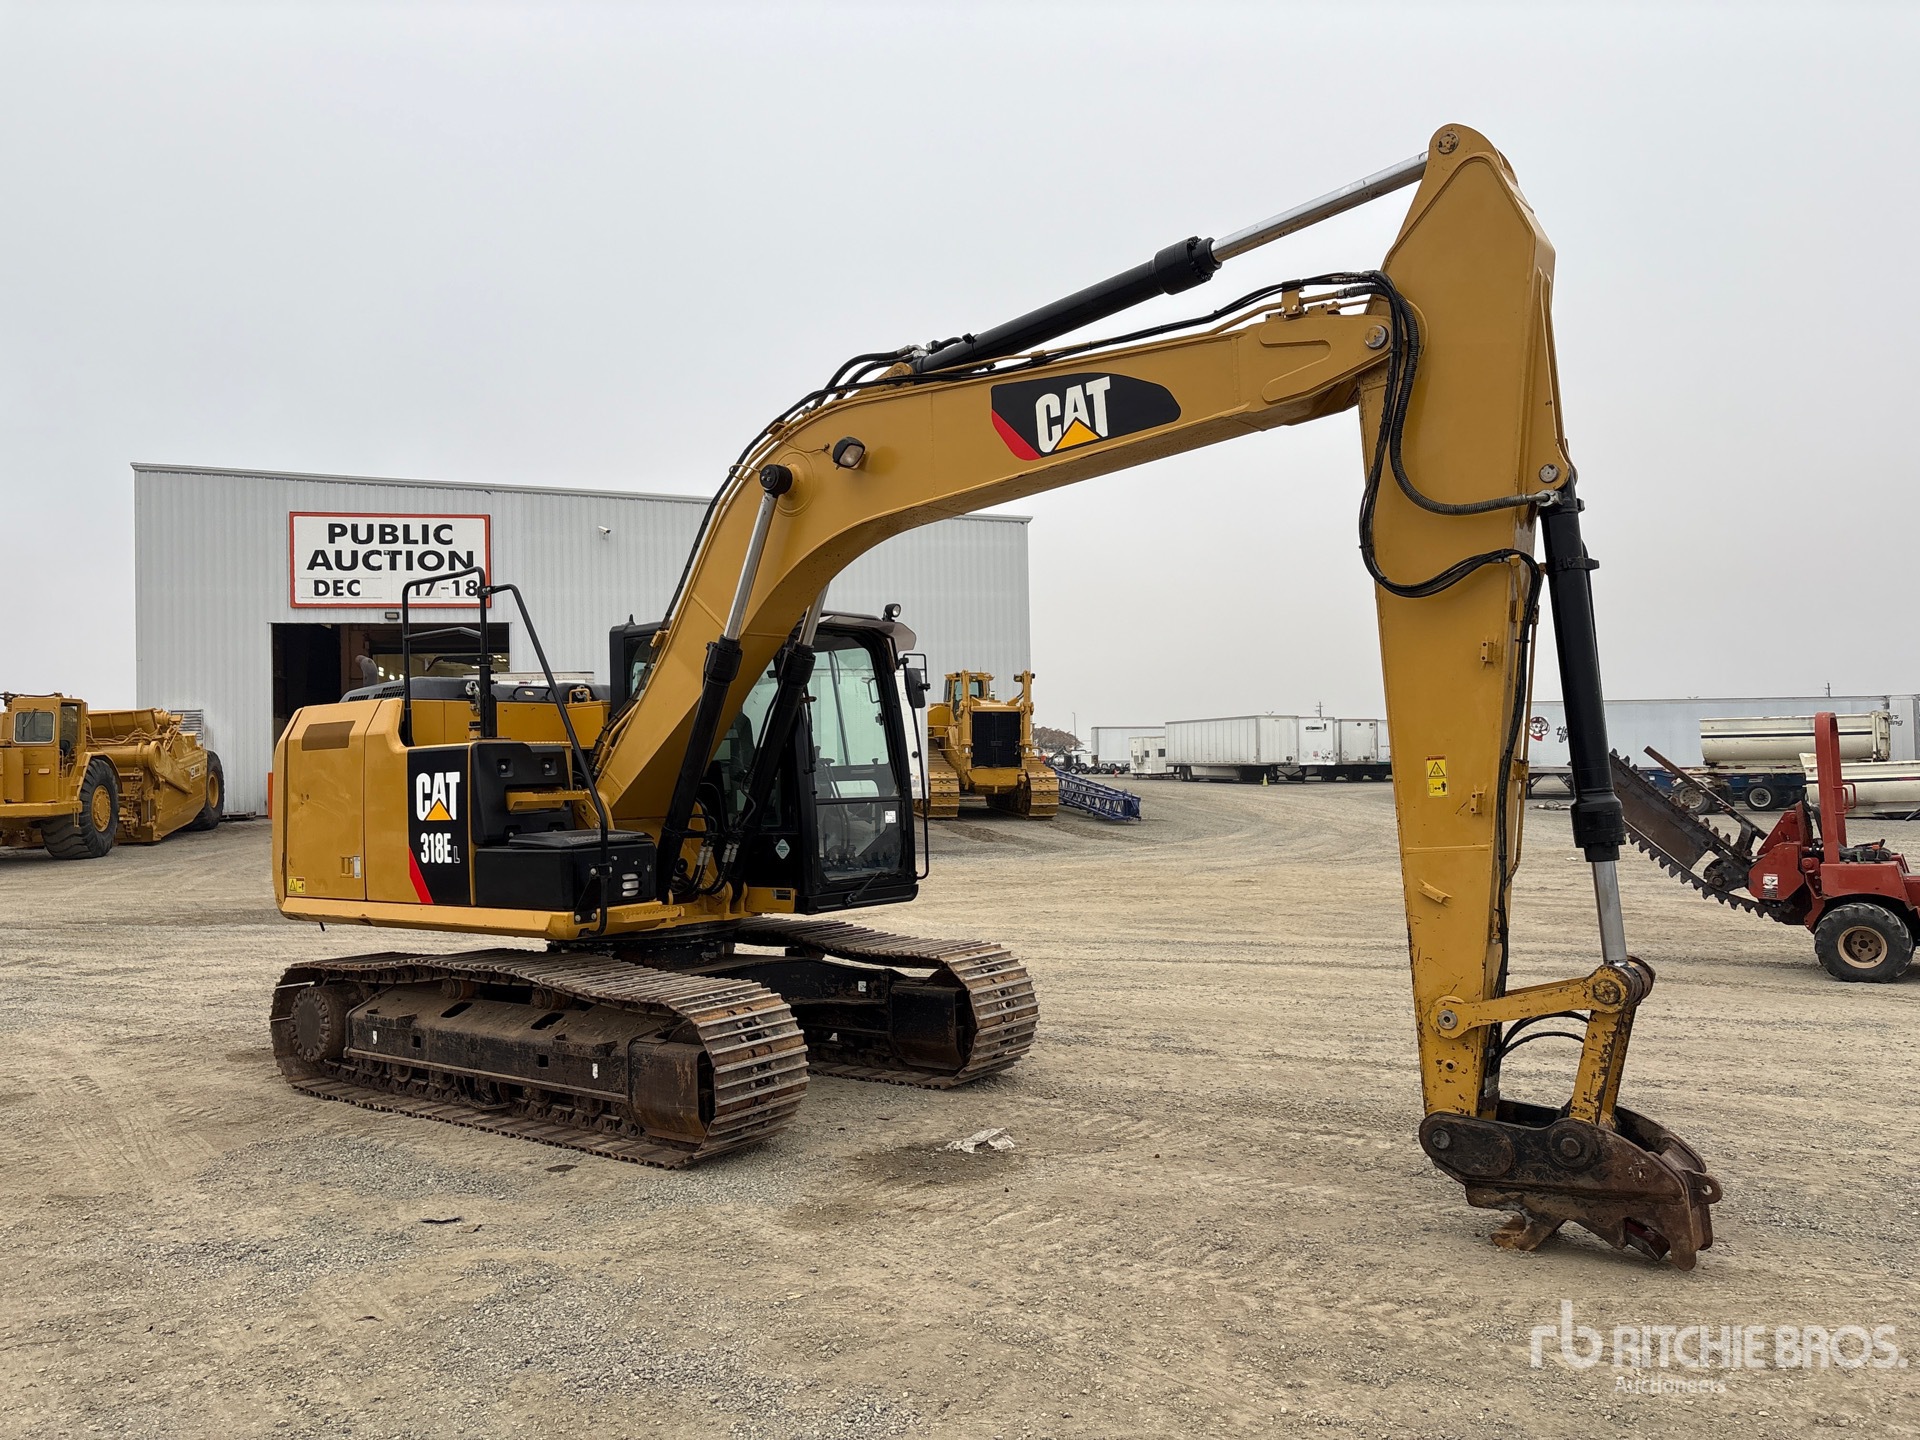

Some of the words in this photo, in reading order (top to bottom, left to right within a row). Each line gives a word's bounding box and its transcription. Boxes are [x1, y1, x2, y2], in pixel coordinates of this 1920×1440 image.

[1035, 376, 1111, 453] CAT
[327, 523, 454, 545] PUBLIC
[306, 549, 474, 572] AUCTION
[313, 579, 361, 597] DEC
[416, 772, 460, 821] CAT
